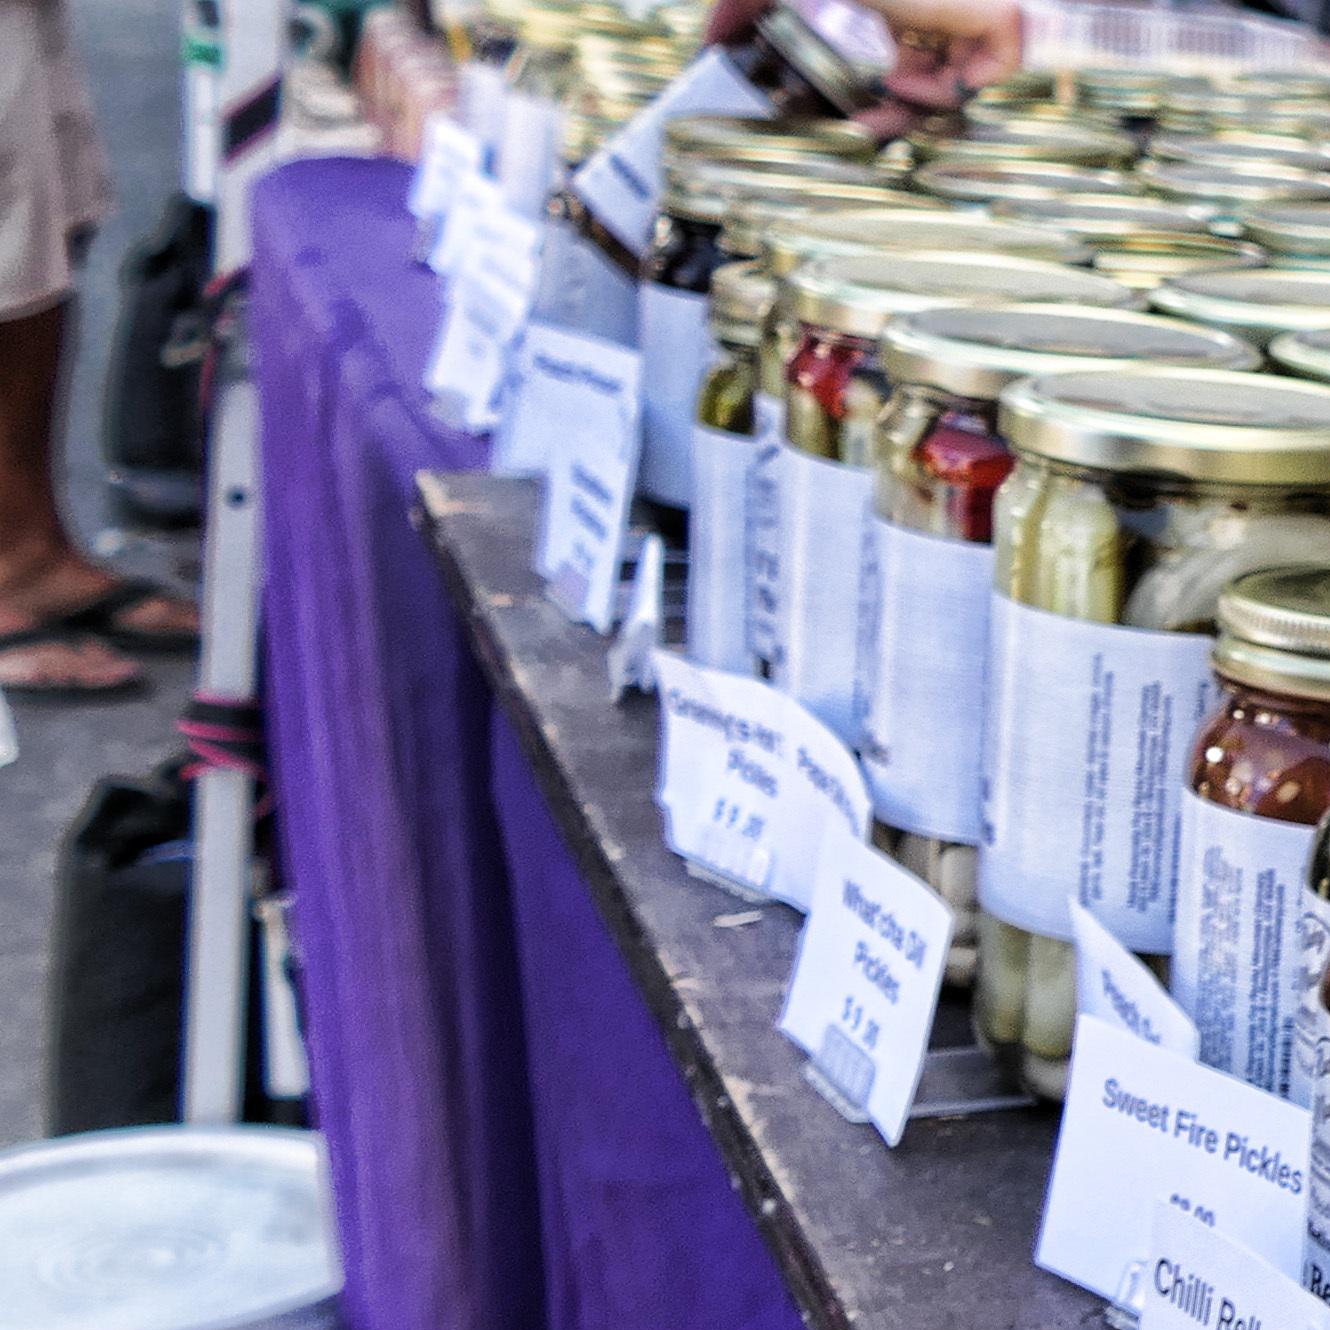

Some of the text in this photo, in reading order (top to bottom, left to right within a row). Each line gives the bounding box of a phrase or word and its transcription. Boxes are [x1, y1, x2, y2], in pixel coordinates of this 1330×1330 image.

[1102, 1078, 1303, 1194] Sweet Fire Pickles
[1154, 1258, 1213, 1325] Chilli
